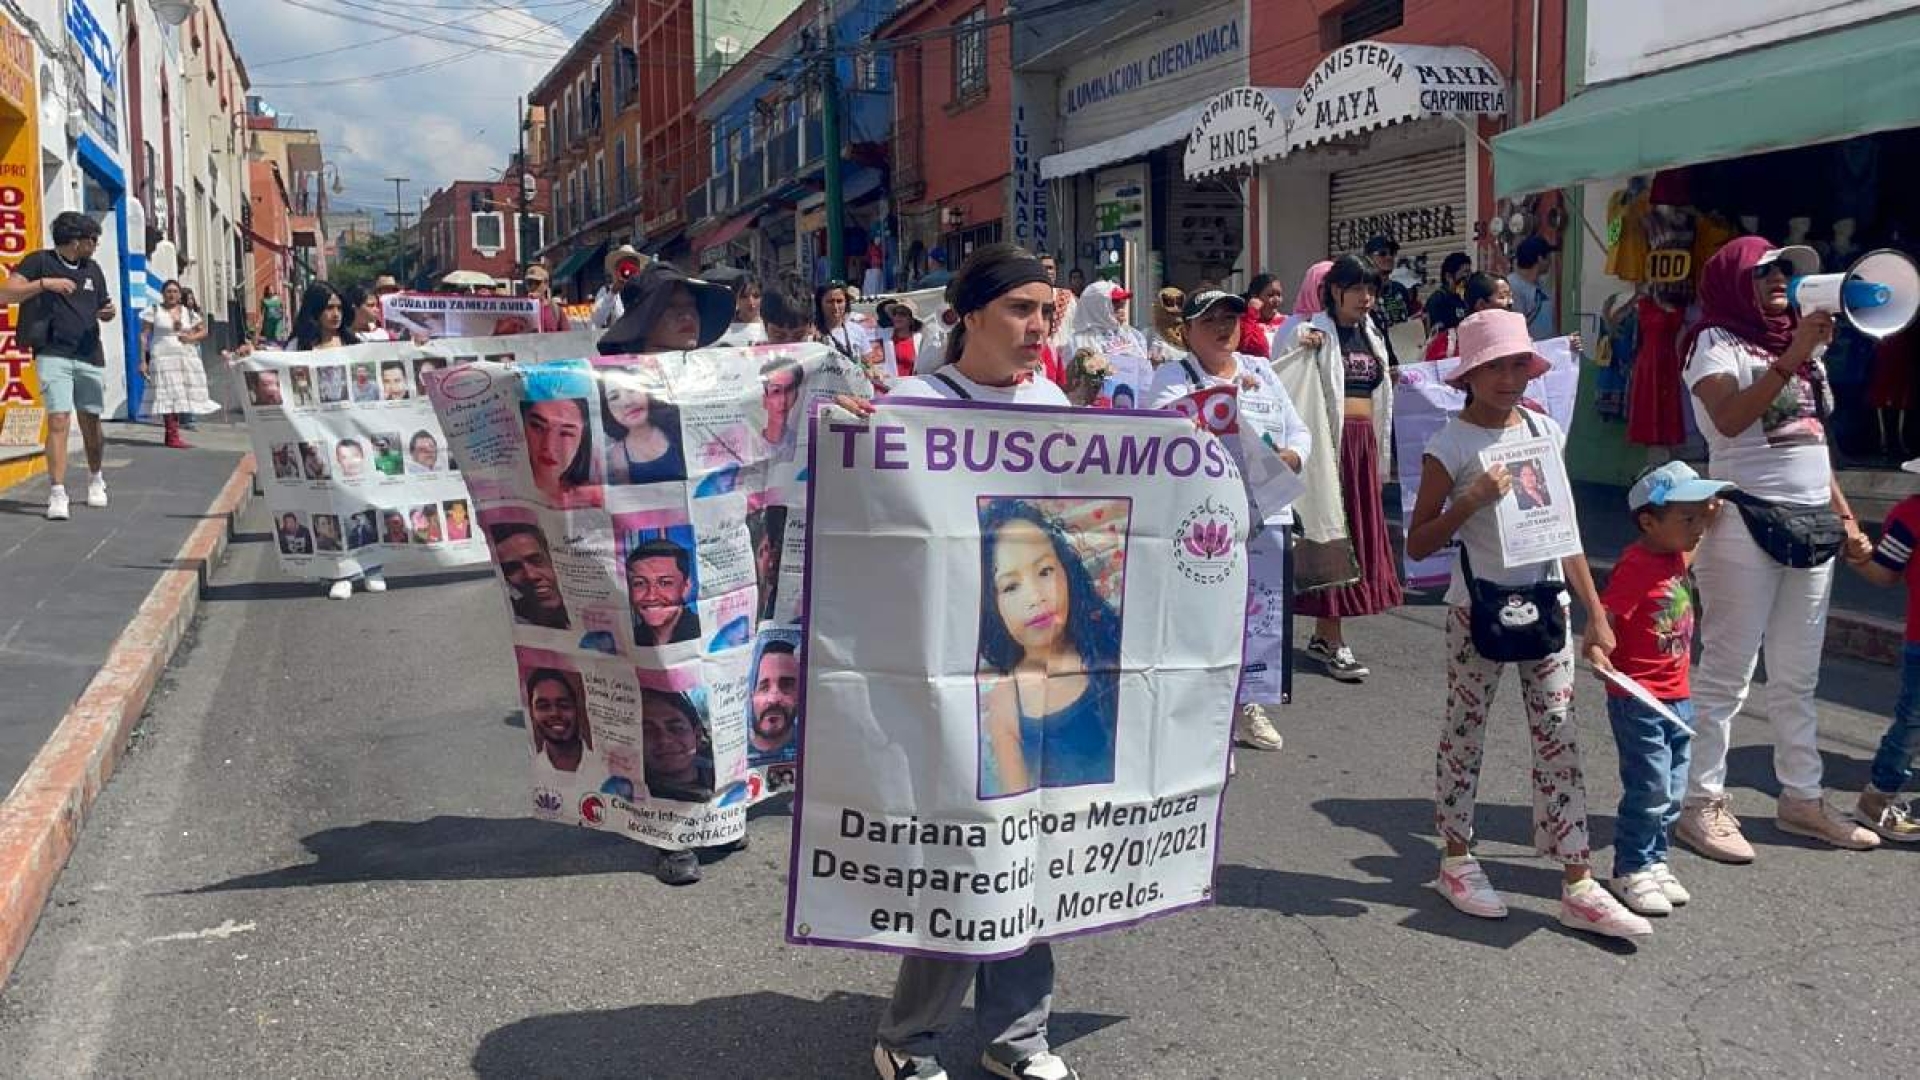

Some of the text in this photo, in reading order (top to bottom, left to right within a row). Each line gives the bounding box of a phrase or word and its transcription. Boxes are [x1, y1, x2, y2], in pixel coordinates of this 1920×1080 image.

[1066, 19, 1241, 113] ILUMINACION CUERNAVACA
[1296, 44, 1403, 116] EBANISTERIA
[1416, 64, 1499, 86] MAYA
[1190, 89, 1276, 155] CARPINTERIA
[1314, 86, 1379, 129] MAYA
[1420, 89, 1506, 112] CARPINTERIA
[1209, 125, 1258, 161] HNOS
[1650, 254, 1686, 278] 100
[0, 302, 34, 402] LATA
[829, 423, 910, 470] TE
[840, 793, 1199, 848] Dariana Ochoa Mendoza
[1049, 848, 1075, 880] el
[1084, 822, 1209, 875] 29/01/2021
[870, 907, 915, 933] en
[1056, 881, 1165, 923] Morelos.
